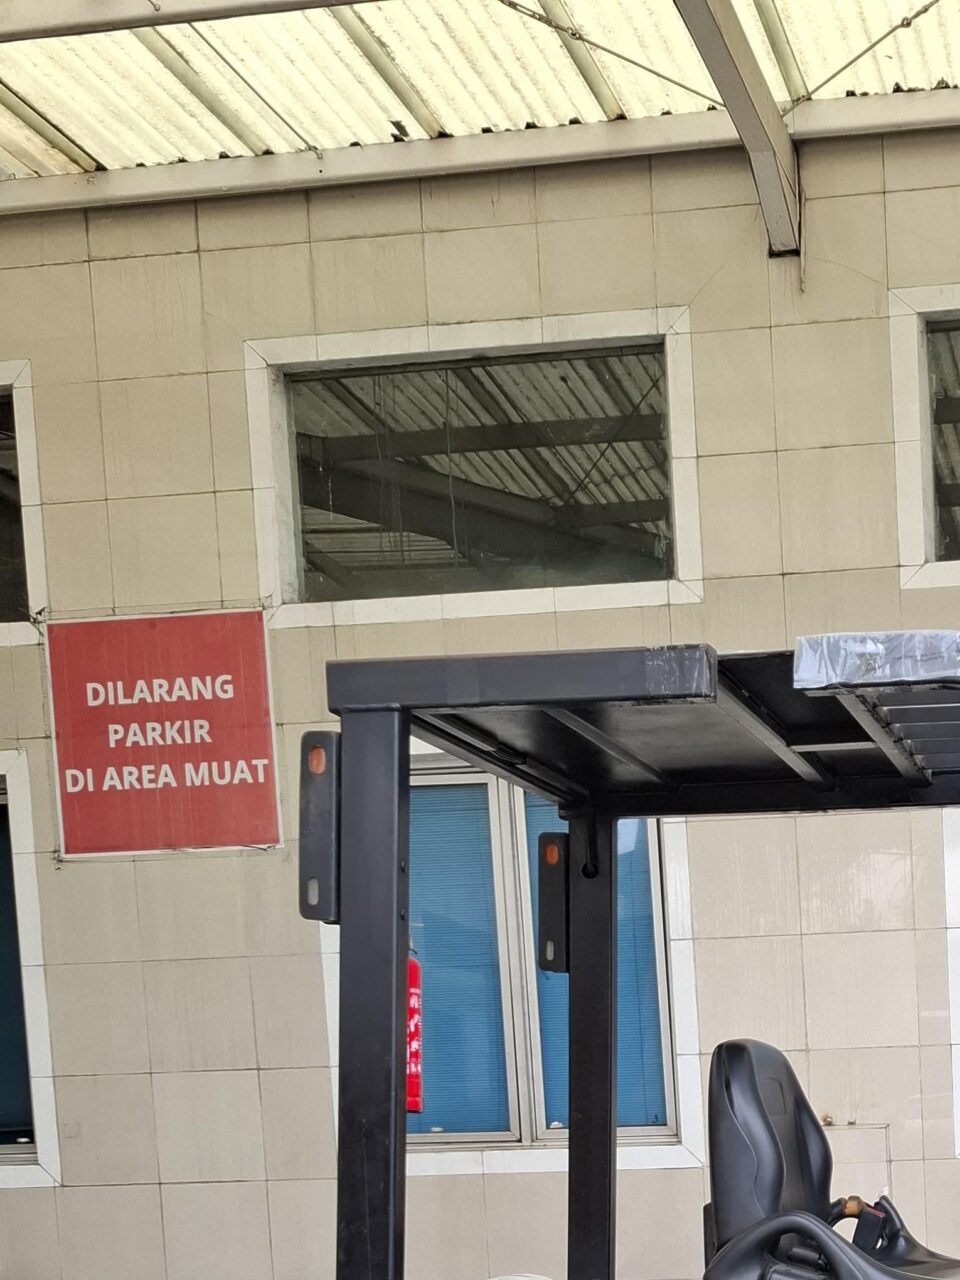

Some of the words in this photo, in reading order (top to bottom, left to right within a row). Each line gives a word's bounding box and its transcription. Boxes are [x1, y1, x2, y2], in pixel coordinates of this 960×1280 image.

[86, 674, 234, 706] DILARANG
[108, 719, 213, 748] PARKIR
[65, 768, 94, 793] DI
[102, 763, 178, 791] AREA
[184, 758, 269, 787] MUAT
